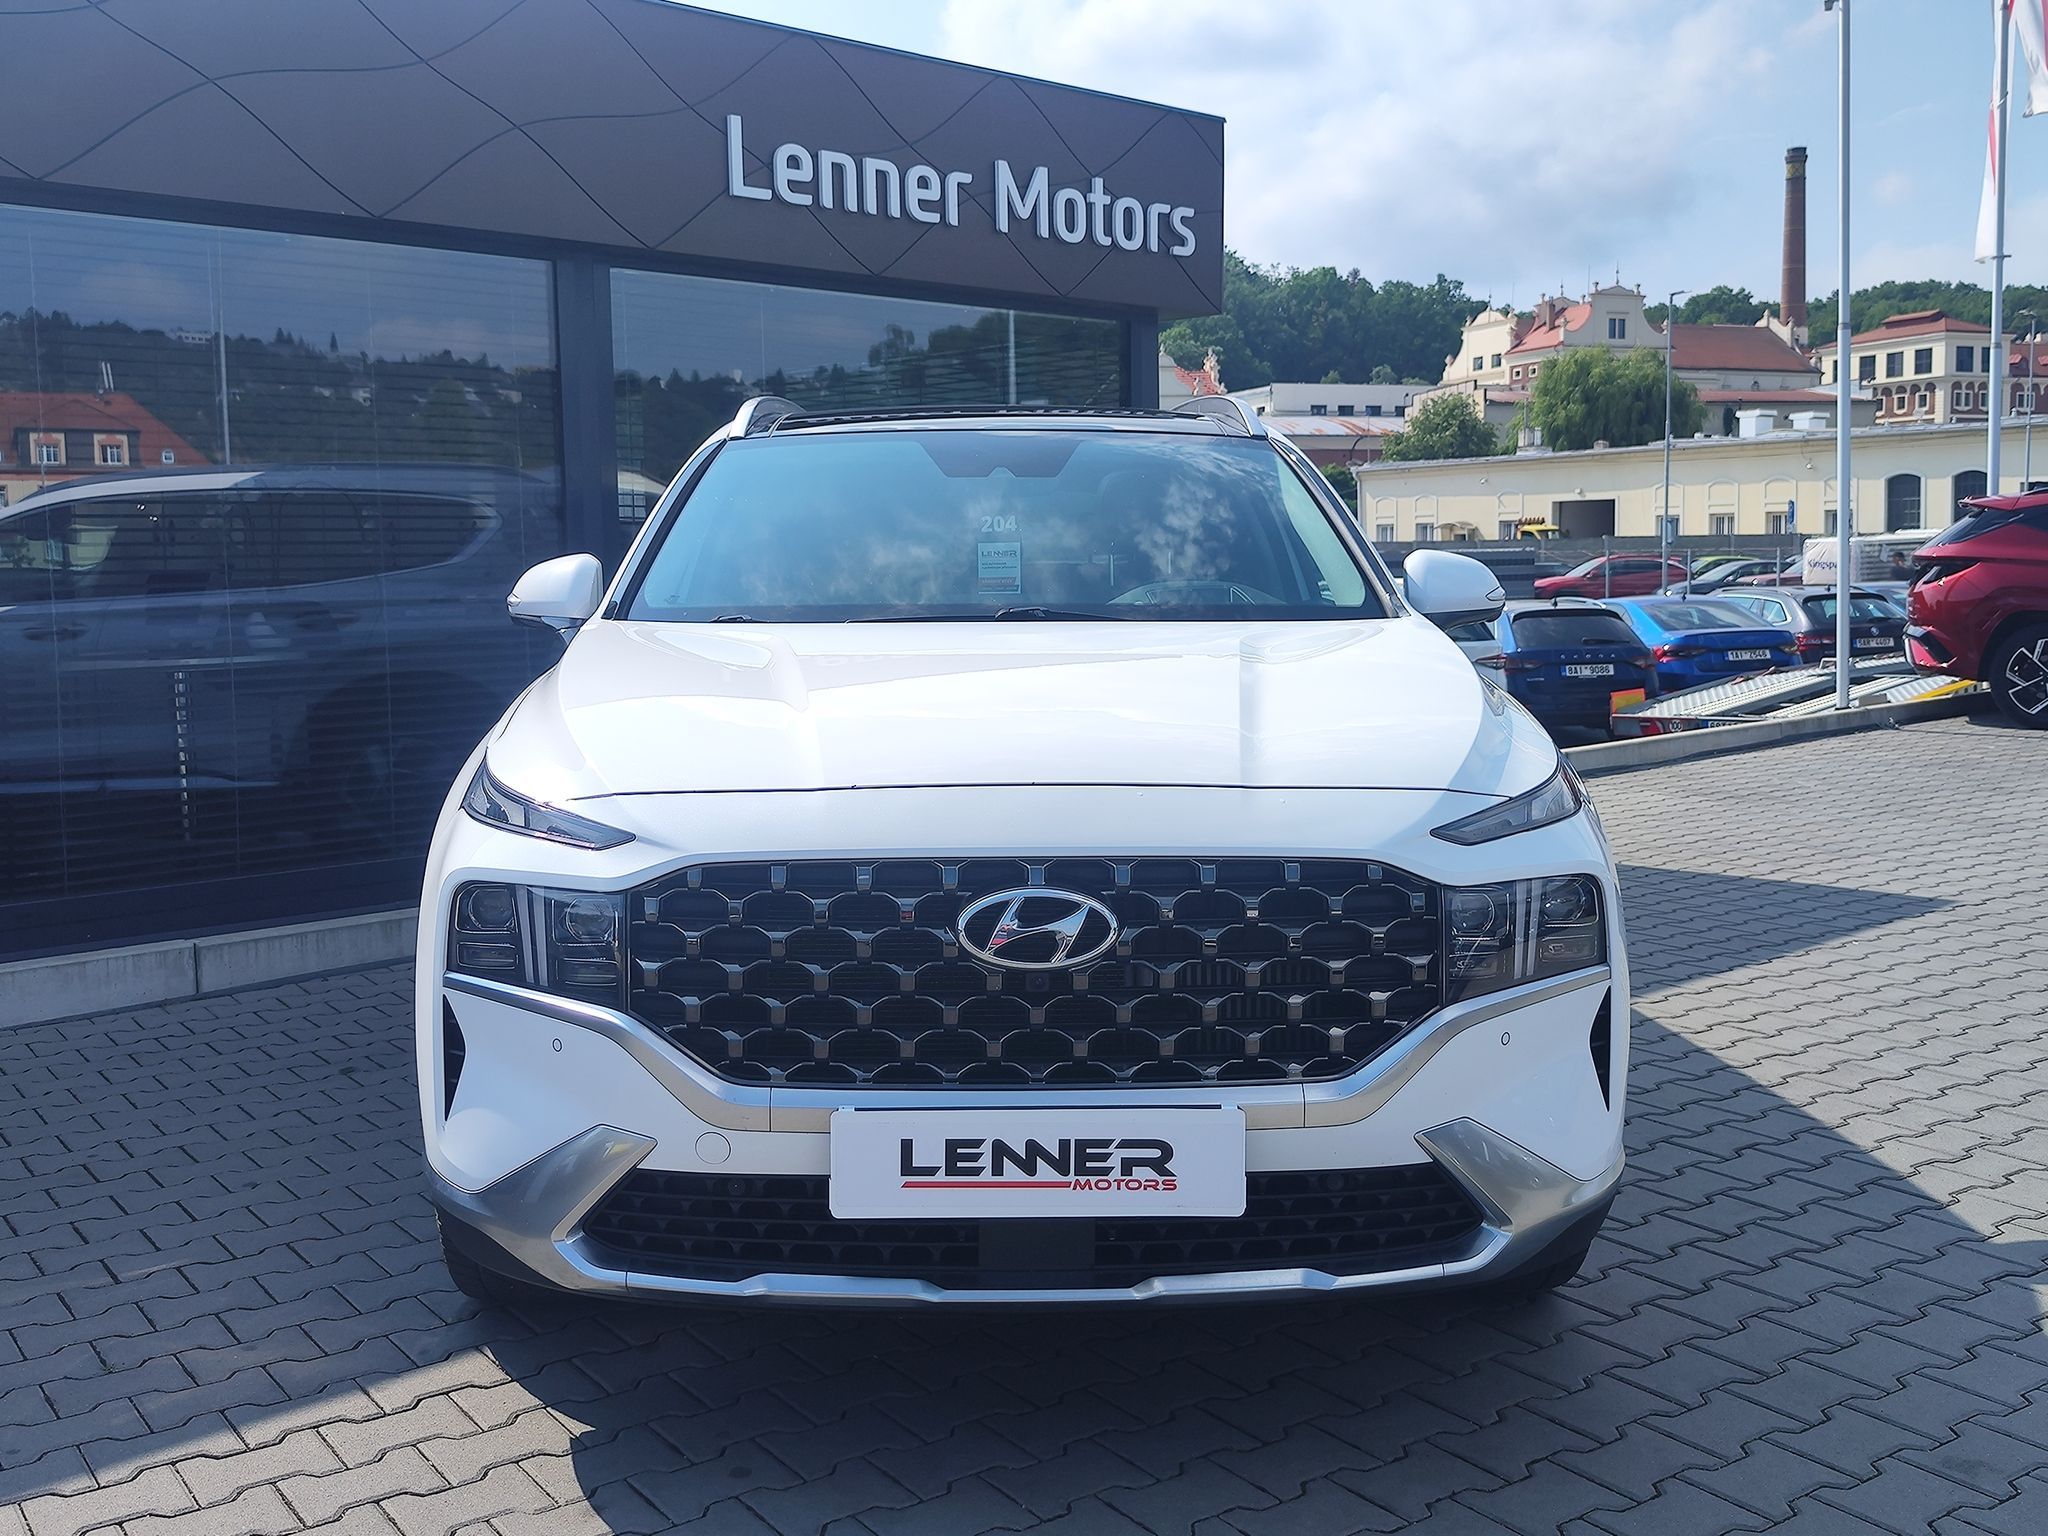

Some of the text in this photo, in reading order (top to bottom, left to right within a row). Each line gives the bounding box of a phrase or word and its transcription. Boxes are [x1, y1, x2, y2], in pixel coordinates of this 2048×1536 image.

[726, 113, 1196, 257] Lenner Motors
[981, 515, 1018, 533] 204
[982, 550, 1018, 559] LENNER
[1567, 665, 1583, 675] 8AI
[900, 1137, 1178, 1177] LENNER
[1072, 1178, 1178, 1191] MOTORS
